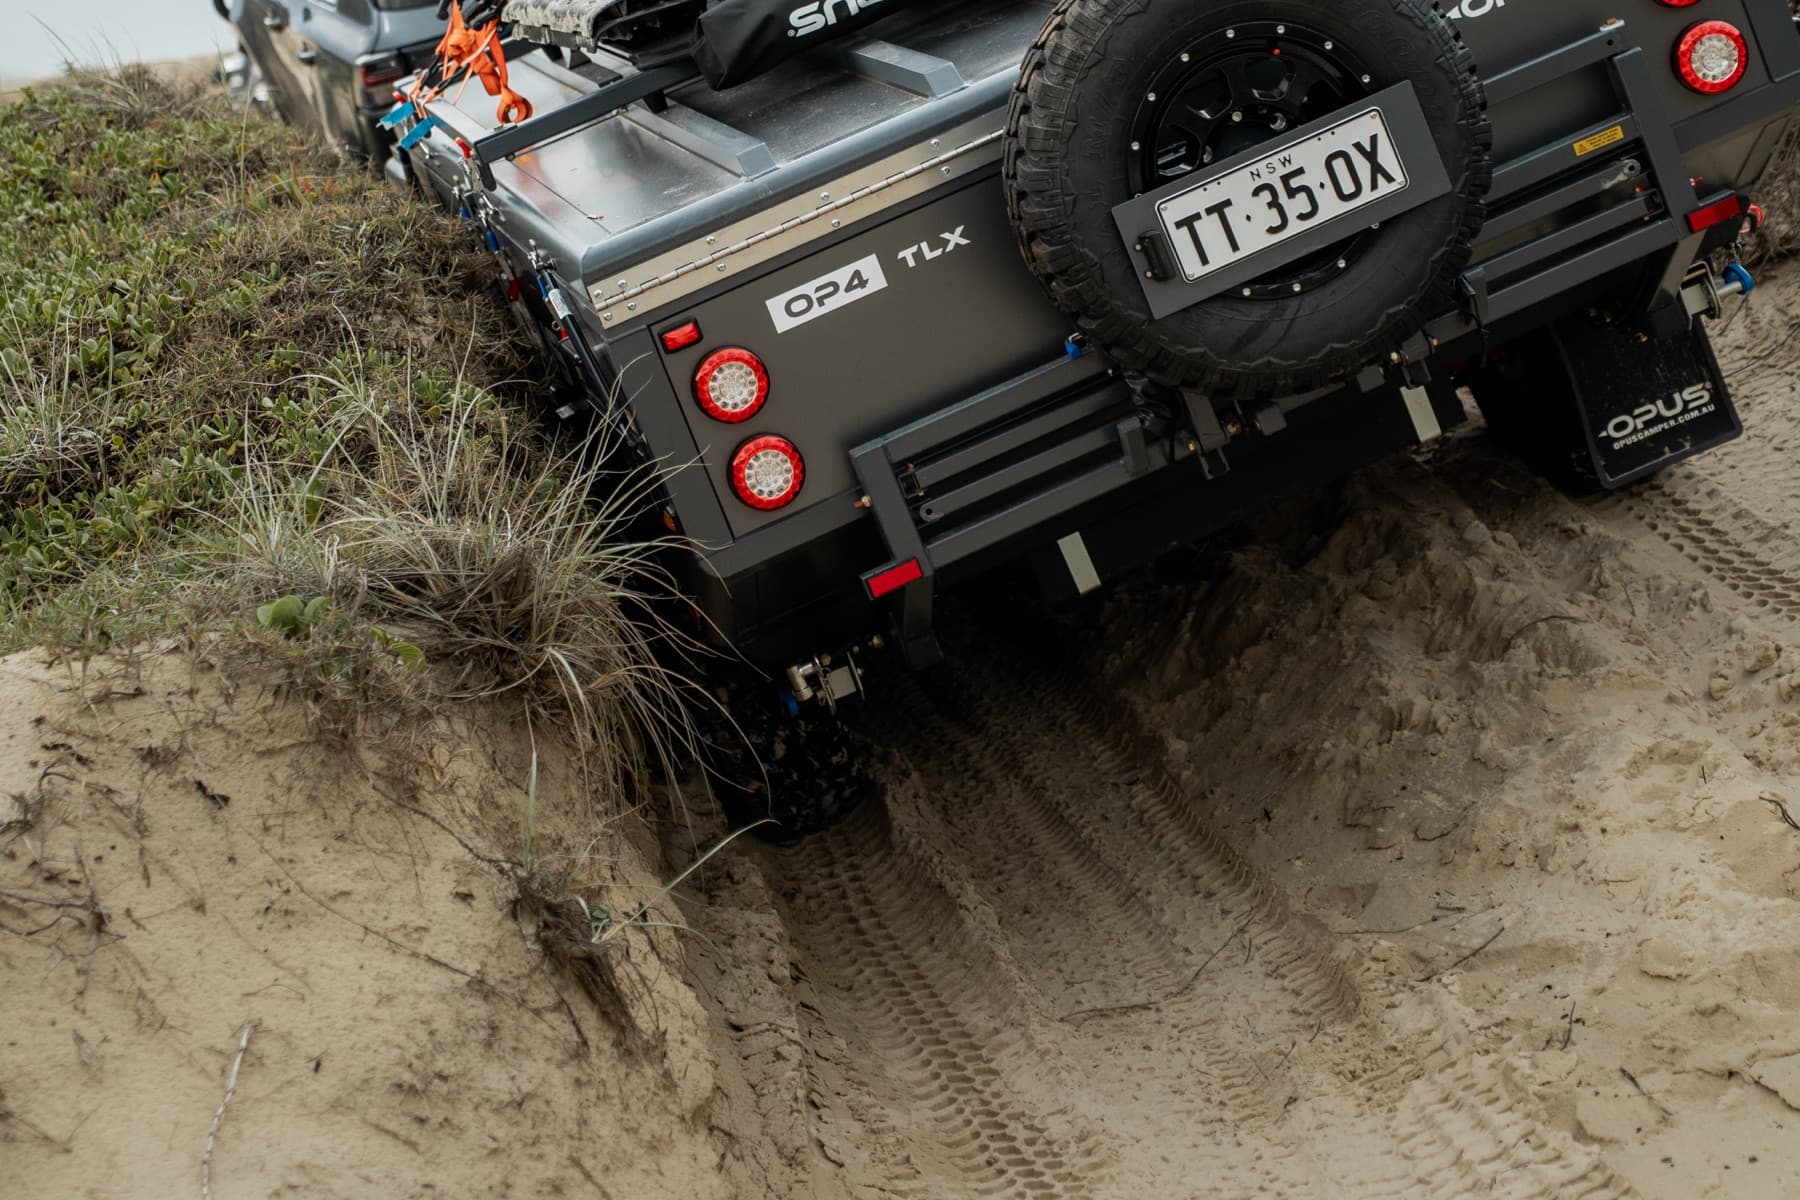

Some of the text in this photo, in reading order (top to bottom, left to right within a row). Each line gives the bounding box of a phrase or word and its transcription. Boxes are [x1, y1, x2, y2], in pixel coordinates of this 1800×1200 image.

[1249, 154, 1294, 183] NSW
[784, 225, 972, 319] OP4 TLX
[1606, 383, 1711, 439] OPUS
[1612, 403, 1716, 451] OPUSCAMPER.COM.AU
